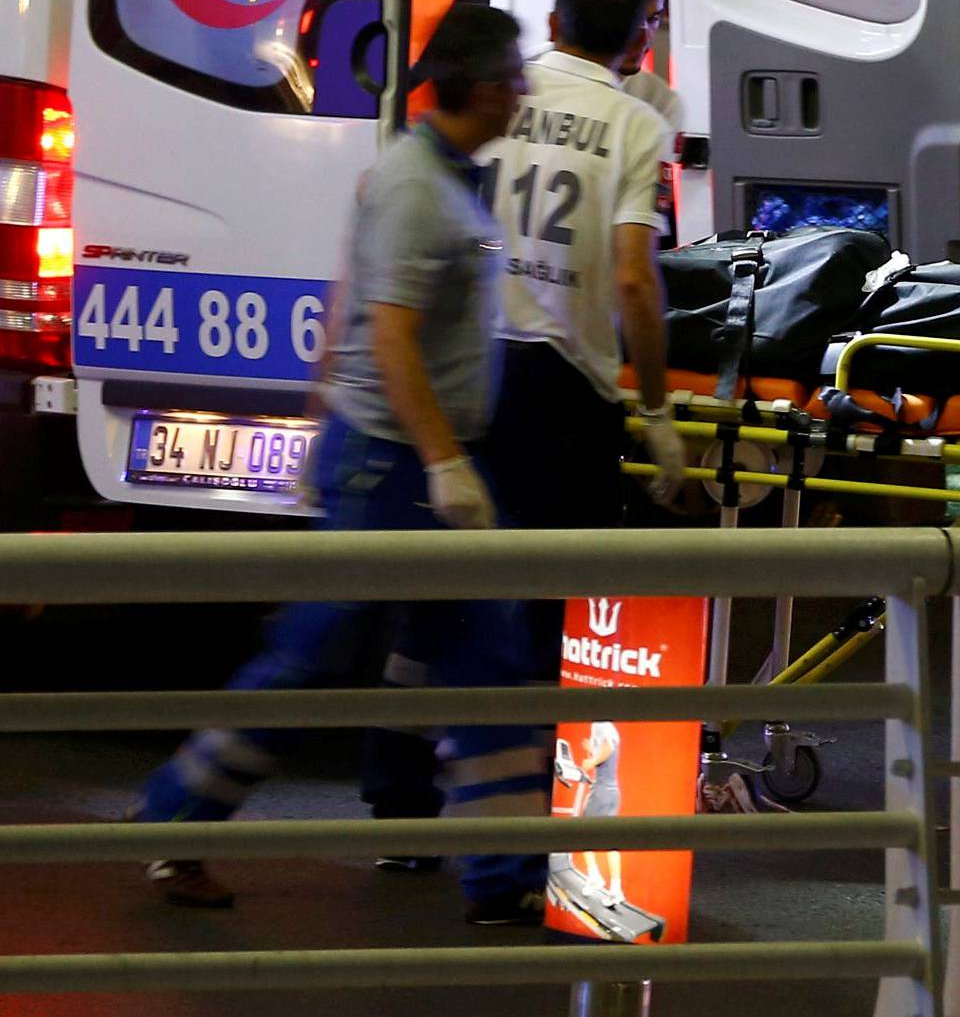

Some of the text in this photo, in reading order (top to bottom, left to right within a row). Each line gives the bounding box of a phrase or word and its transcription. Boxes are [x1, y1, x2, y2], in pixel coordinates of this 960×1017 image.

[509, 105, 610, 159] ANBUL
[81, 244, 191, 267] SPRINTER
[77, 283, 180, 355] 444
[198, 289, 270, 360] 88
[150, 425, 185, 469] 34
[200, 429, 239, 471] NJ
